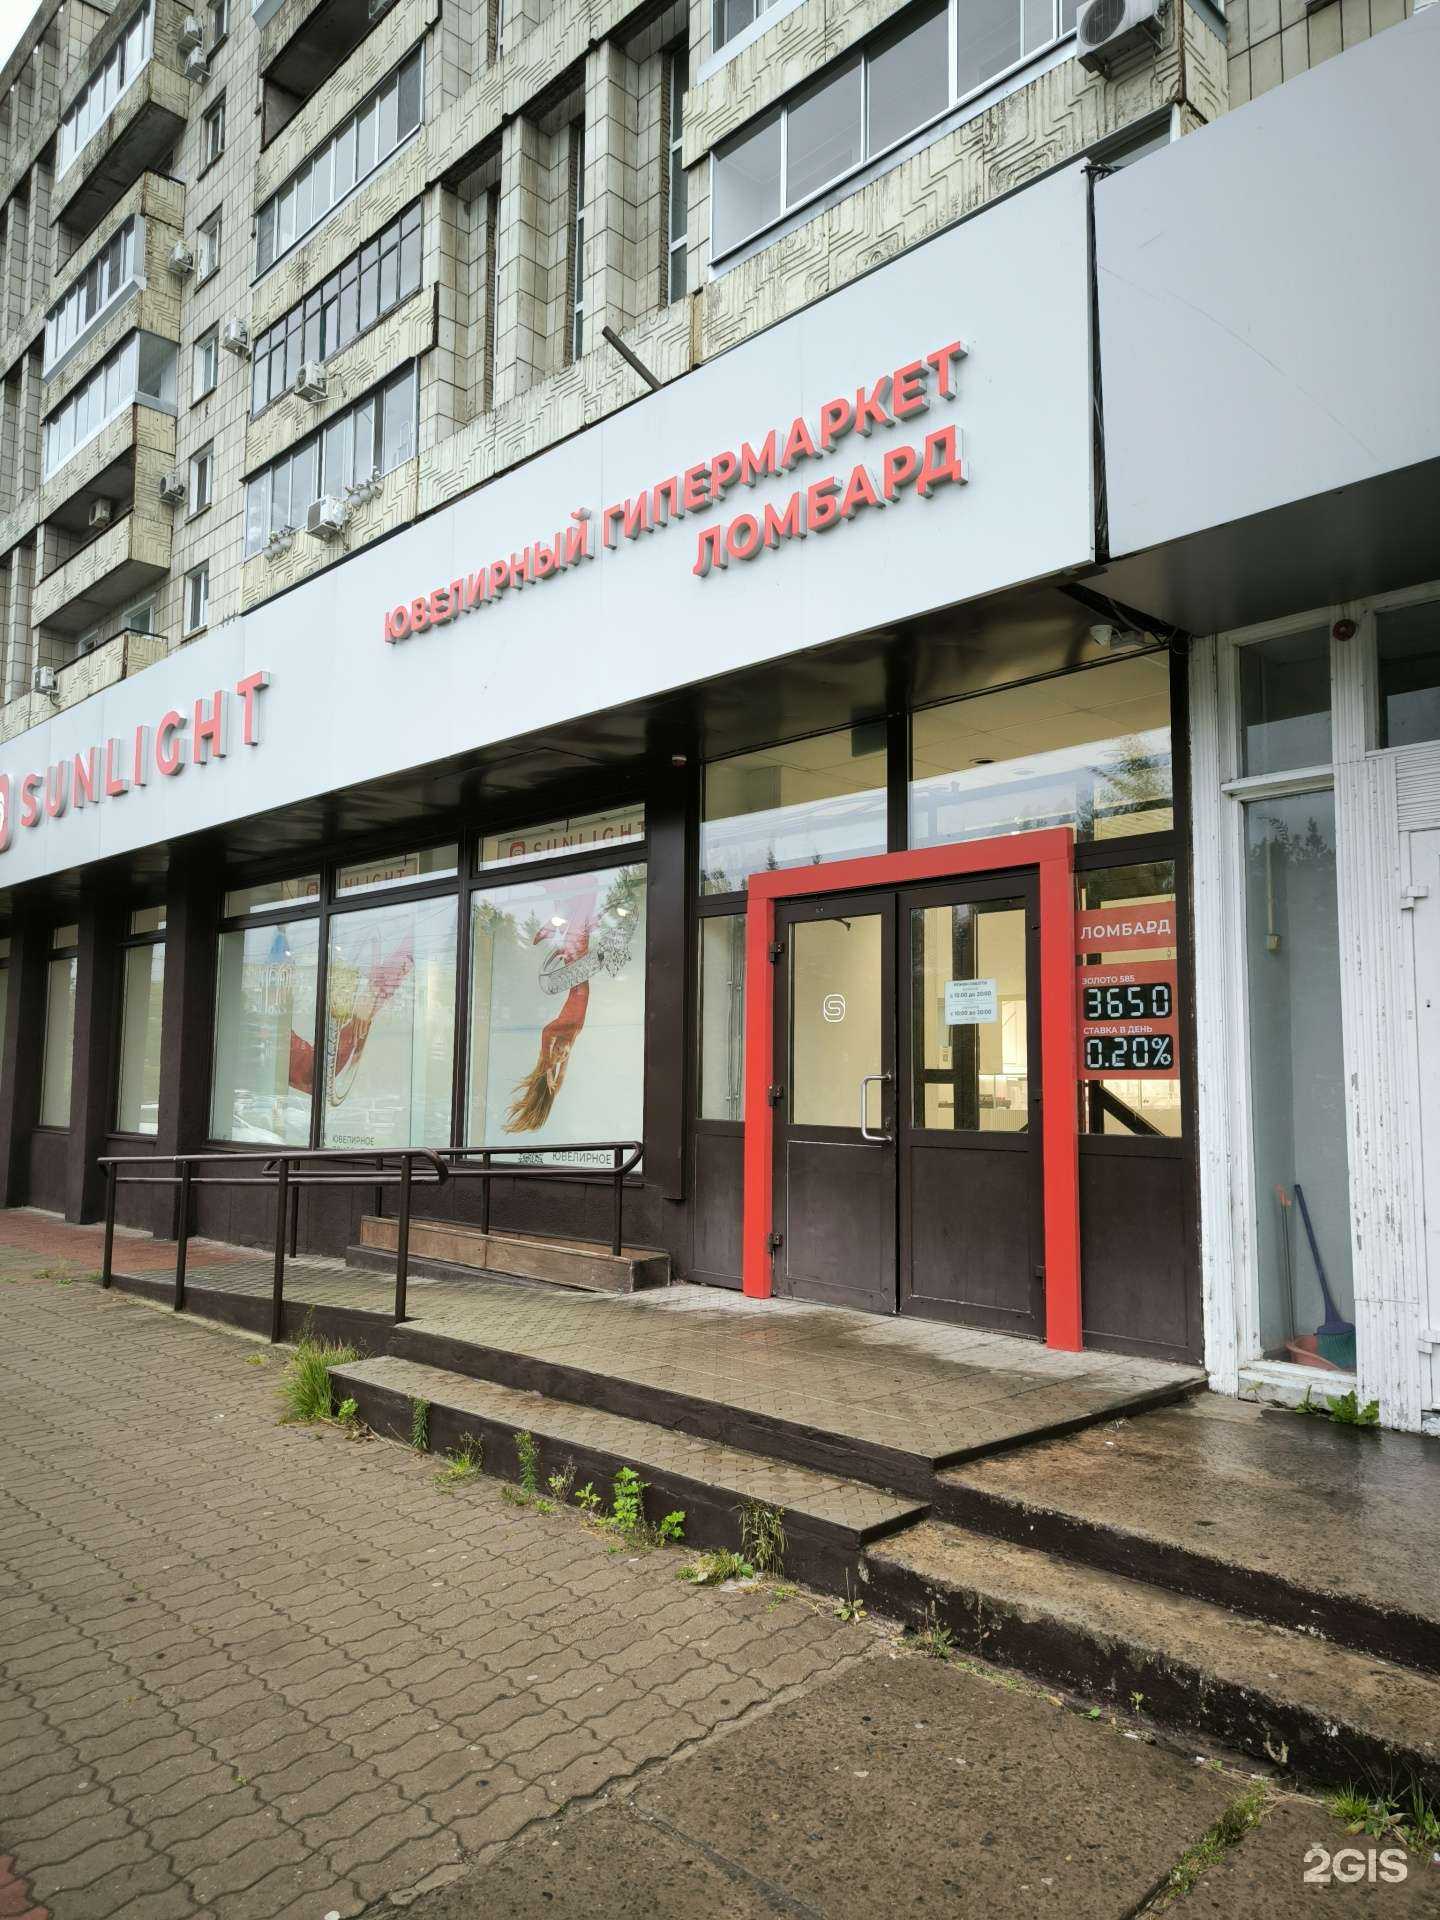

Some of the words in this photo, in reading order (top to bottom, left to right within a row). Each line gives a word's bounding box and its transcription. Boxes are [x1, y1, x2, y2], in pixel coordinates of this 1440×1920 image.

[385, 507, 595, 644] ЮВЕЛИРНЫЙ
[603, 340, 968, 550] ГИПЕРМАРКЕТ
[693, 424, 968, 578] ЛОМБАРД
[21, 671, 271, 828] SUNLIGHT
[1082, 976, 1118, 985] ЗОЛОТО
[1120, 975, 1135, 983] 585
[1088, 986, 1169, 1017] 3650
[1083, 1026, 1118, 1034] СТАВКА
[1128, 1025, 1153, 1033] ДЕНЬ
[1087, 1037, 1171, 1067] 0.20%
[332, 1134, 376, 1146] ЮВЕЛИРНОЕ
[552, 1151, 612, 1164] ЮВЕЛИРНОЕ
